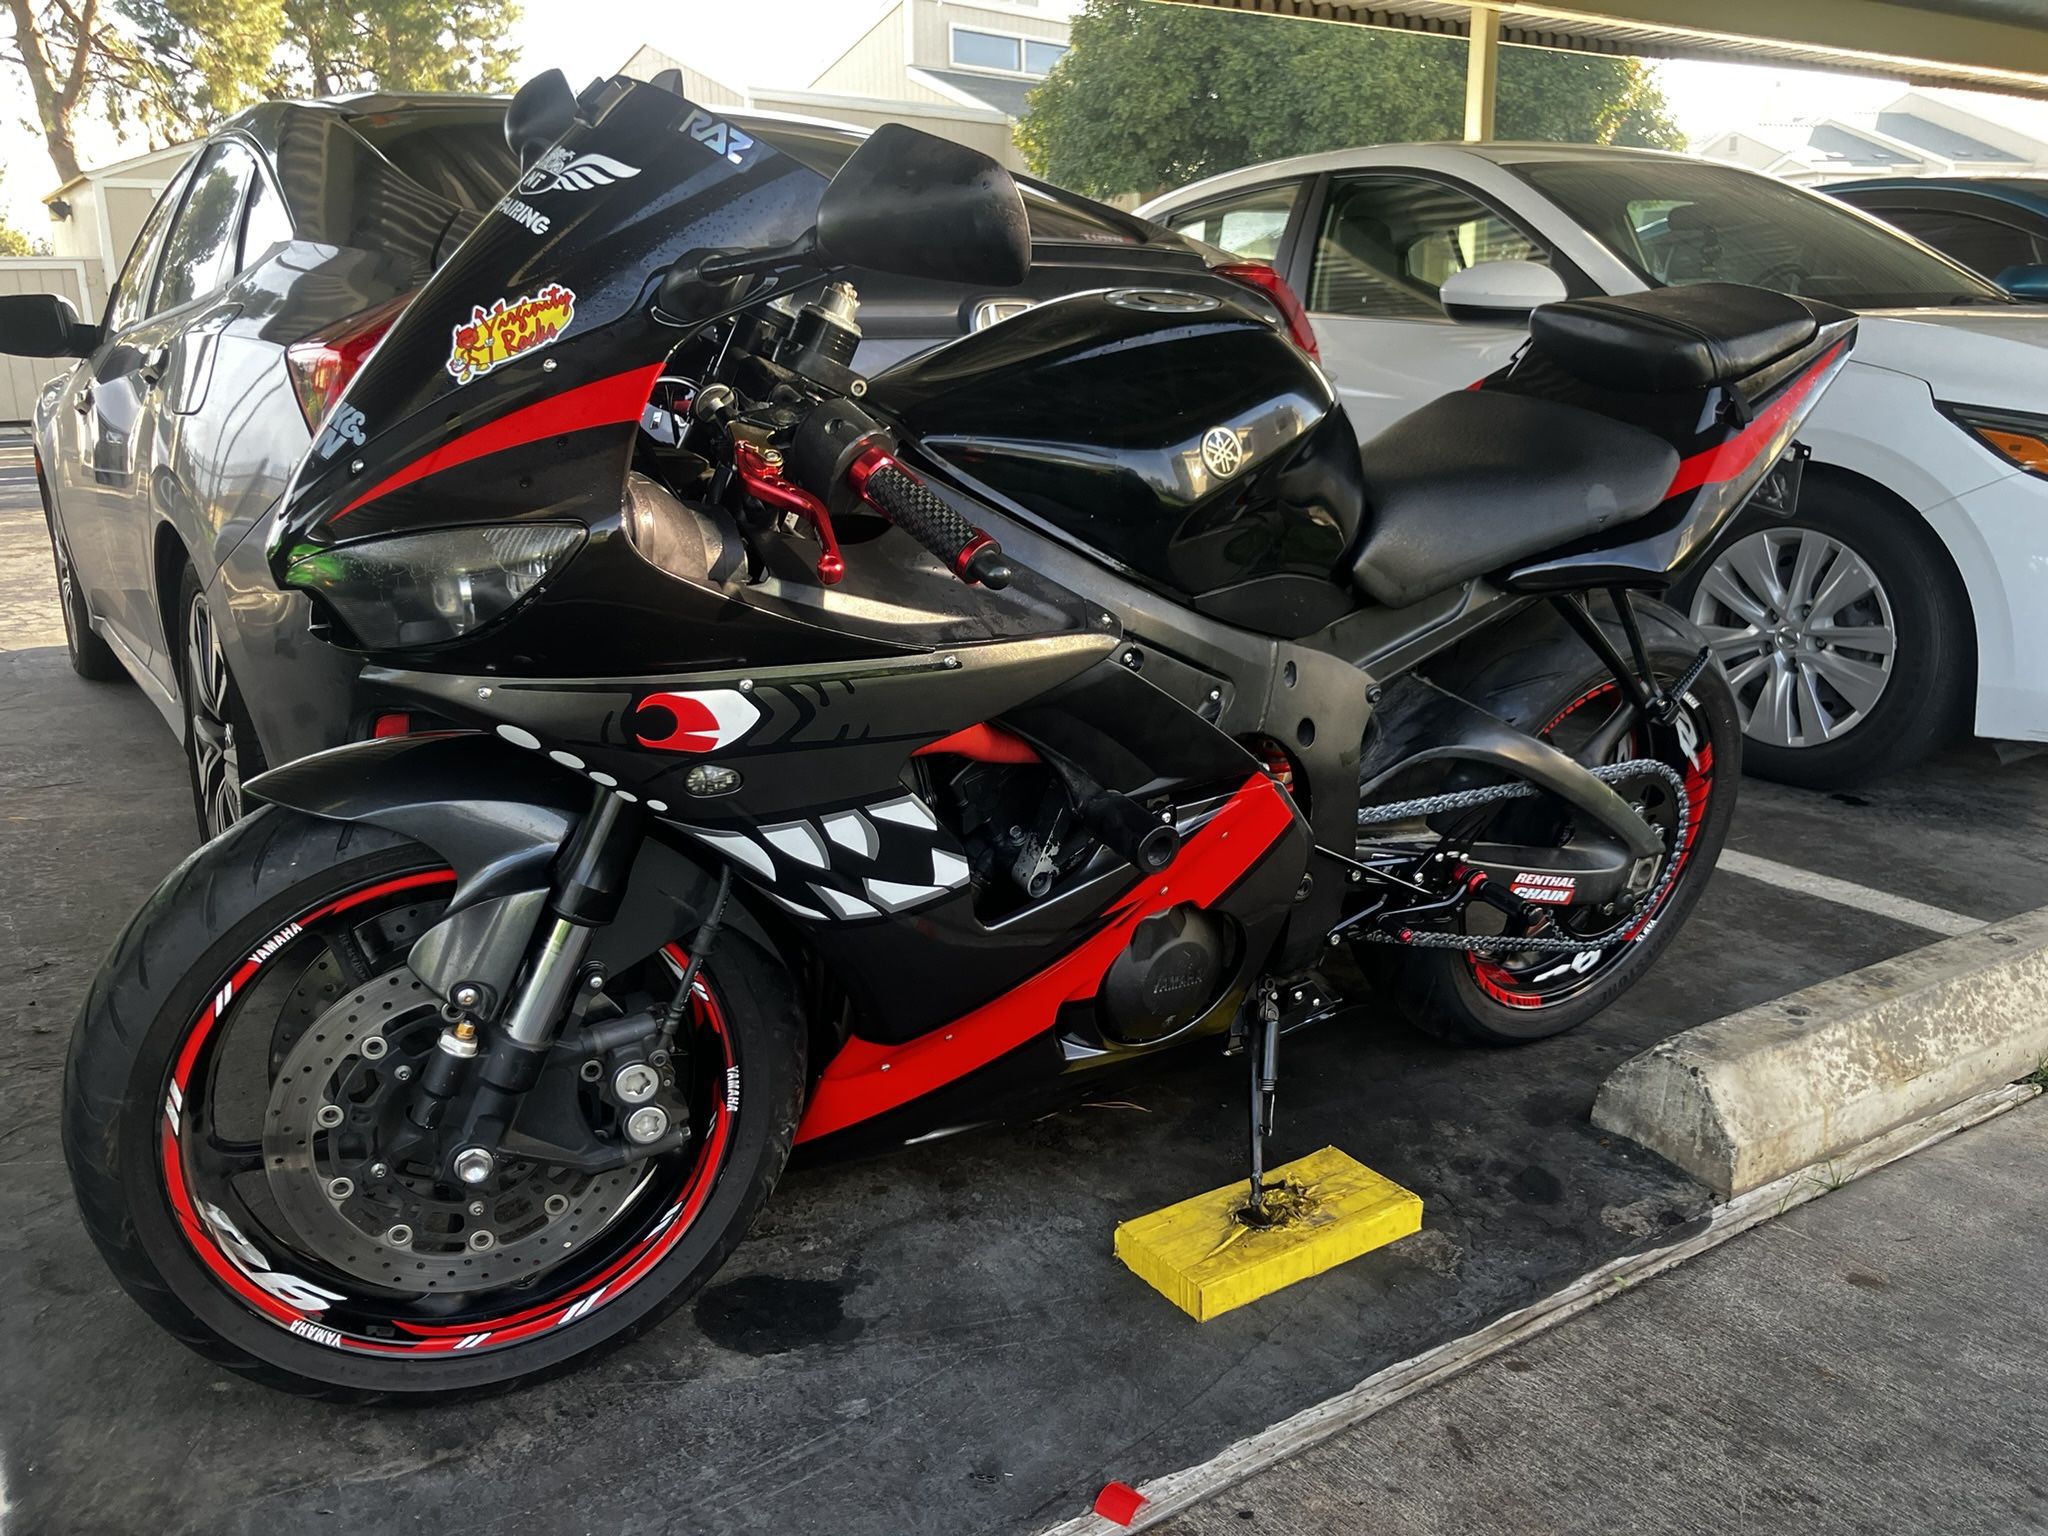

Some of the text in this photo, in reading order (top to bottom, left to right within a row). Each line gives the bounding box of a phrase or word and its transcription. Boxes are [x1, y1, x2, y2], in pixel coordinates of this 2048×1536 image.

[1513, 886, 1571, 902] CHAIN
[1514, 872, 1576, 888] RENTHAL
[247, 922, 303, 964] YAMAHA
[726, 1064, 740, 1112] YAMAHA
[290, 1318, 342, 1348] YAMAHA
